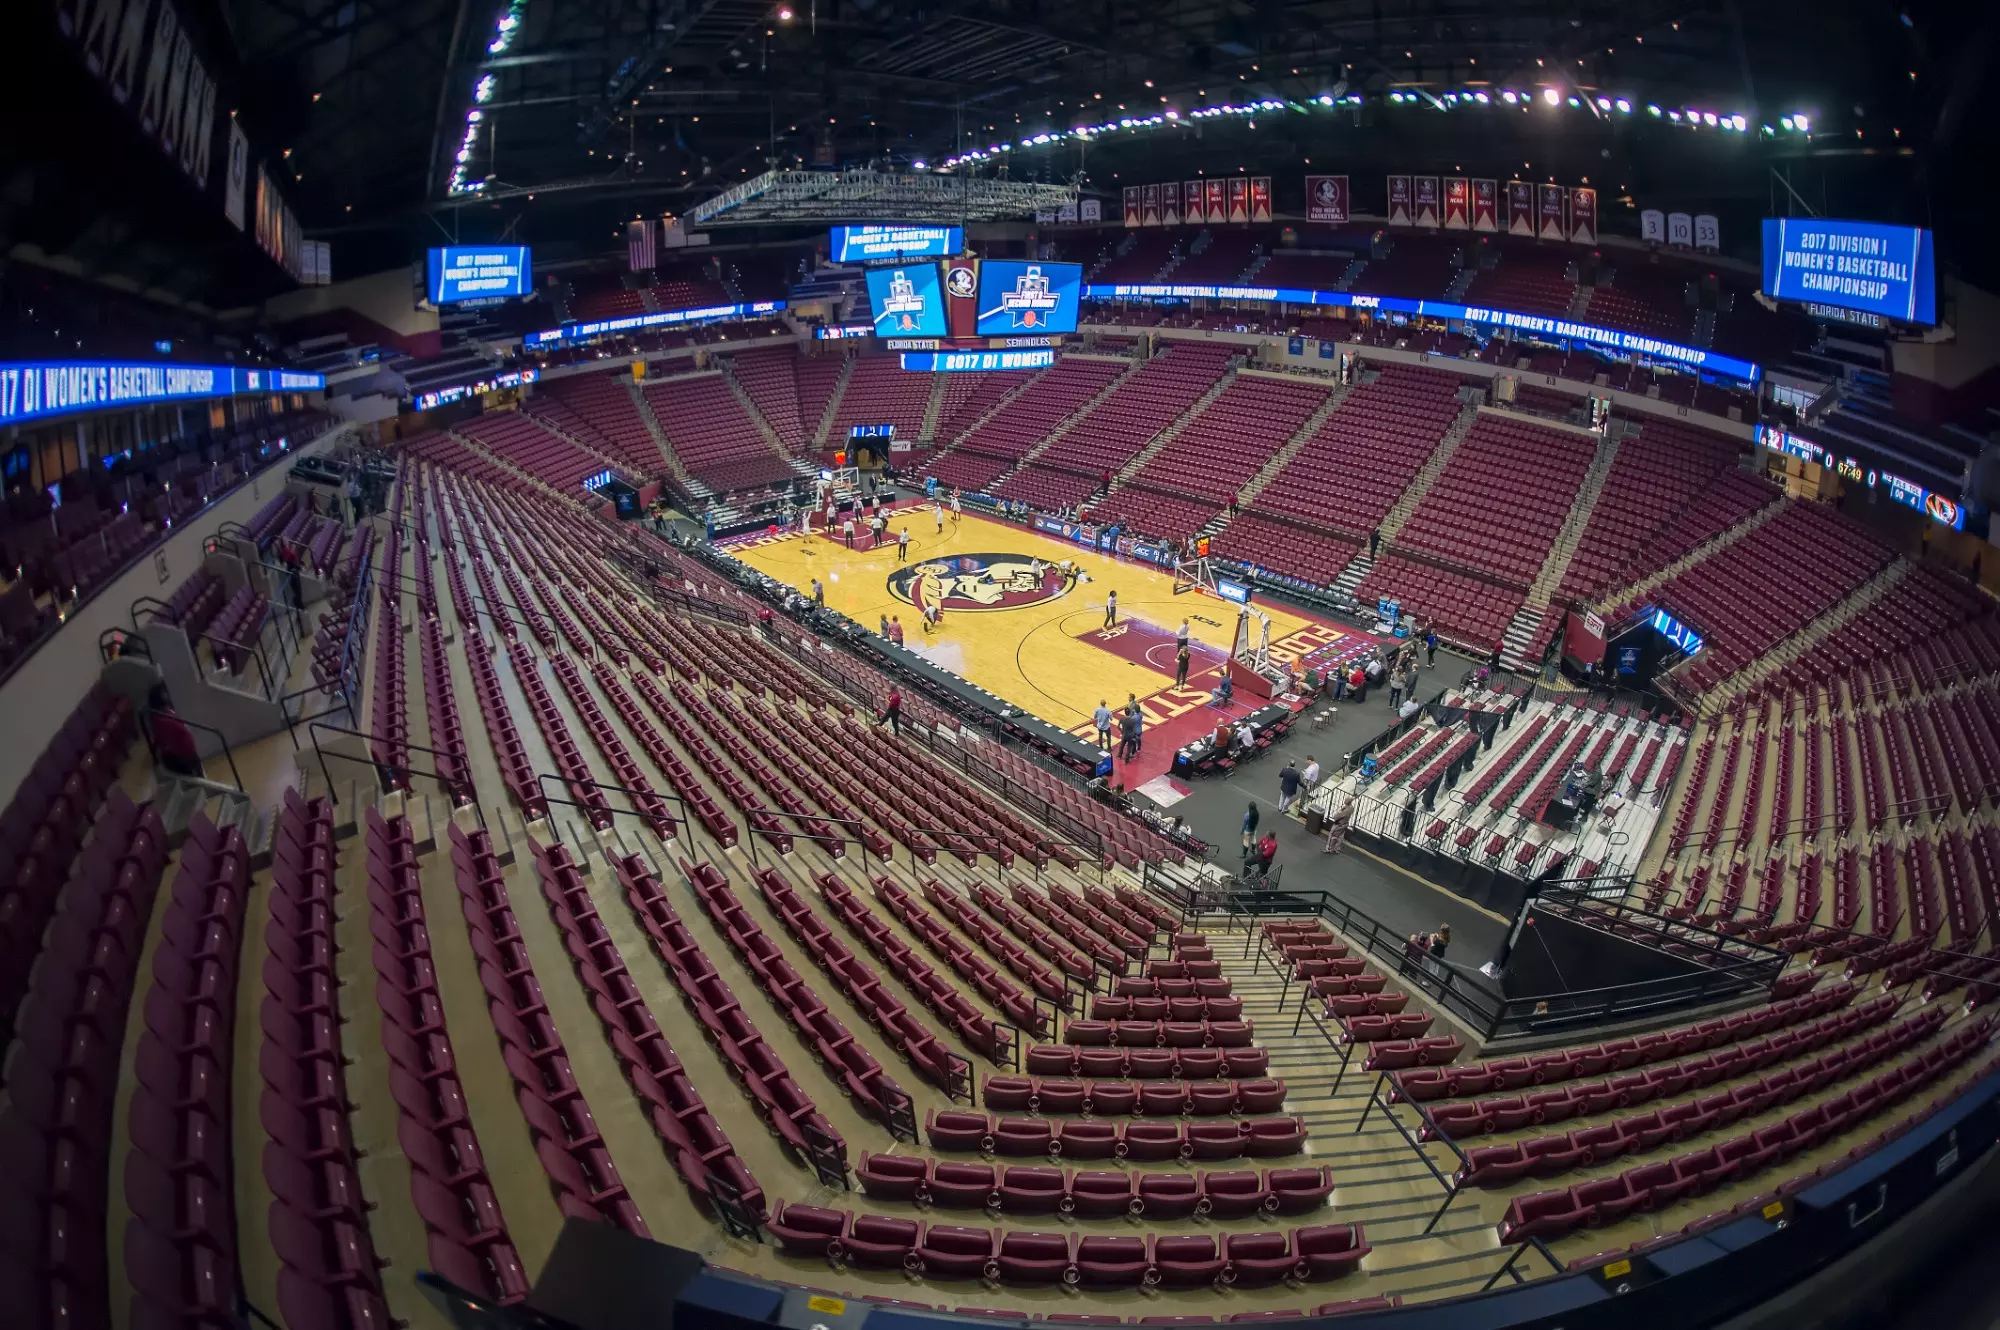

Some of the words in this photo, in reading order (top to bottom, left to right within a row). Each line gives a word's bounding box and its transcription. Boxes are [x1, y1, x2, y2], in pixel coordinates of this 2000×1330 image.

[1085, 207, 1097, 217] 13
[1649, 221, 1657, 234] 3
[1674, 225, 1688, 238] 10
[1700, 227, 1716, 240] 33
[891, 229, 945, 242] BASKETBALL
[1802, 232, 1825, 249] 2017
[1829, 234, 1879, 256] DIVISION
[1883, 239, 1887, 257] I
[1785, 251, 1834, 271] WOMEN'S
[1837, 255, 1908, 282] BASKETBALL
[1173, 286, 1216, 297] BASKETBALL
[1217, 287, 1277, 300] CHAMPIONSHIP
[1802, 272, 1888, 300] CHAMPIONSHIP
[1810, 303, 1846, 320] FLORIDA
[1849, 310, 1880, 326] STATE
[1005, 337, 1051, 347] SEMINOLES
[1464, 307, 1489, 321] 2017
[1491, 310, 1503, 323] DI
[1505, 313, 1554, 332] WOMEN'S
[1556, 321, 1620, 346] BASKETBALL
[1623, 335, 1706, 364] CHAMPIONSHIP
[887, 340, 912, 349] FLORIDA
[913, 340, 934, 349] STATE
[946, 355, 979, 369] 2017
[982, 354, 998, 369] DI
[1001, 351, 1049, 368] WOMEN'S
[24, 367, 41, 413] DI
[45, 366, 107, 409] WOMEN'S
[110, 367, 166, 400] BASKETBALL
[166, 368, 214, 394] CHAMPIONSHIP
[1825, 453, 1833, 468] 0
[1838, 462, 1862, 480] 67:49
[1868, 472, 1876, 486] 0
[1134, 547, 1150, 557] ACC
[1097, 624, 1129, 641] ACC
